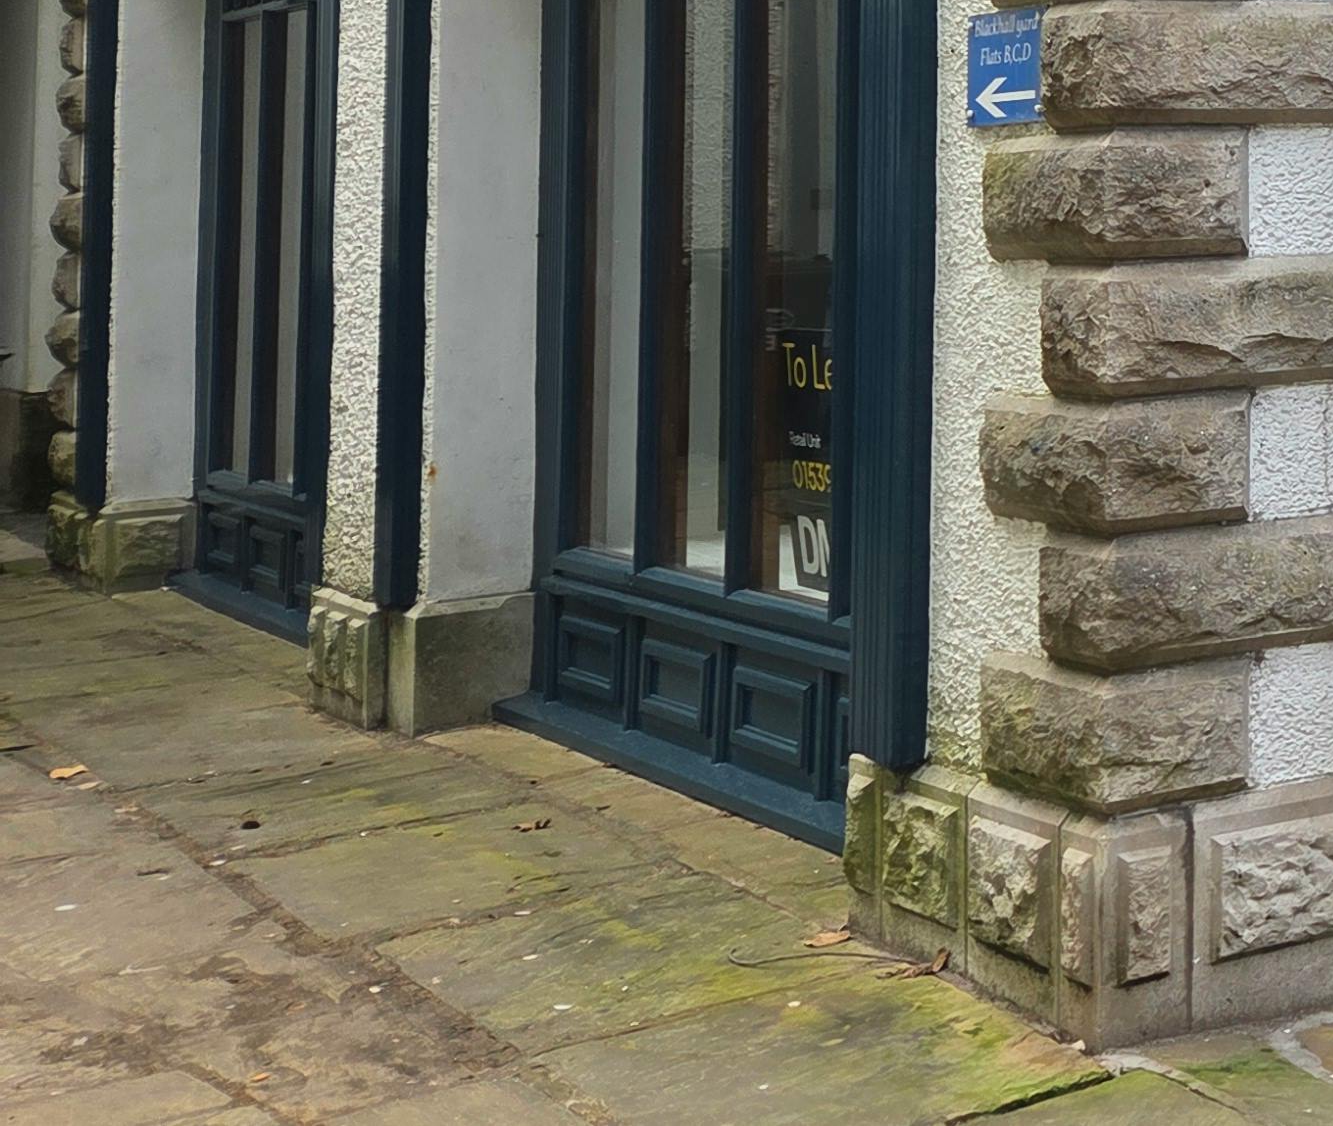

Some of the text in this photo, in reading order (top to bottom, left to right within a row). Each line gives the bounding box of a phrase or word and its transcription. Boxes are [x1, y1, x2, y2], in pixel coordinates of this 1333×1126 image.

[980, 46, 1002, 66] Flats
[781, 342, 833, 390] To Le
